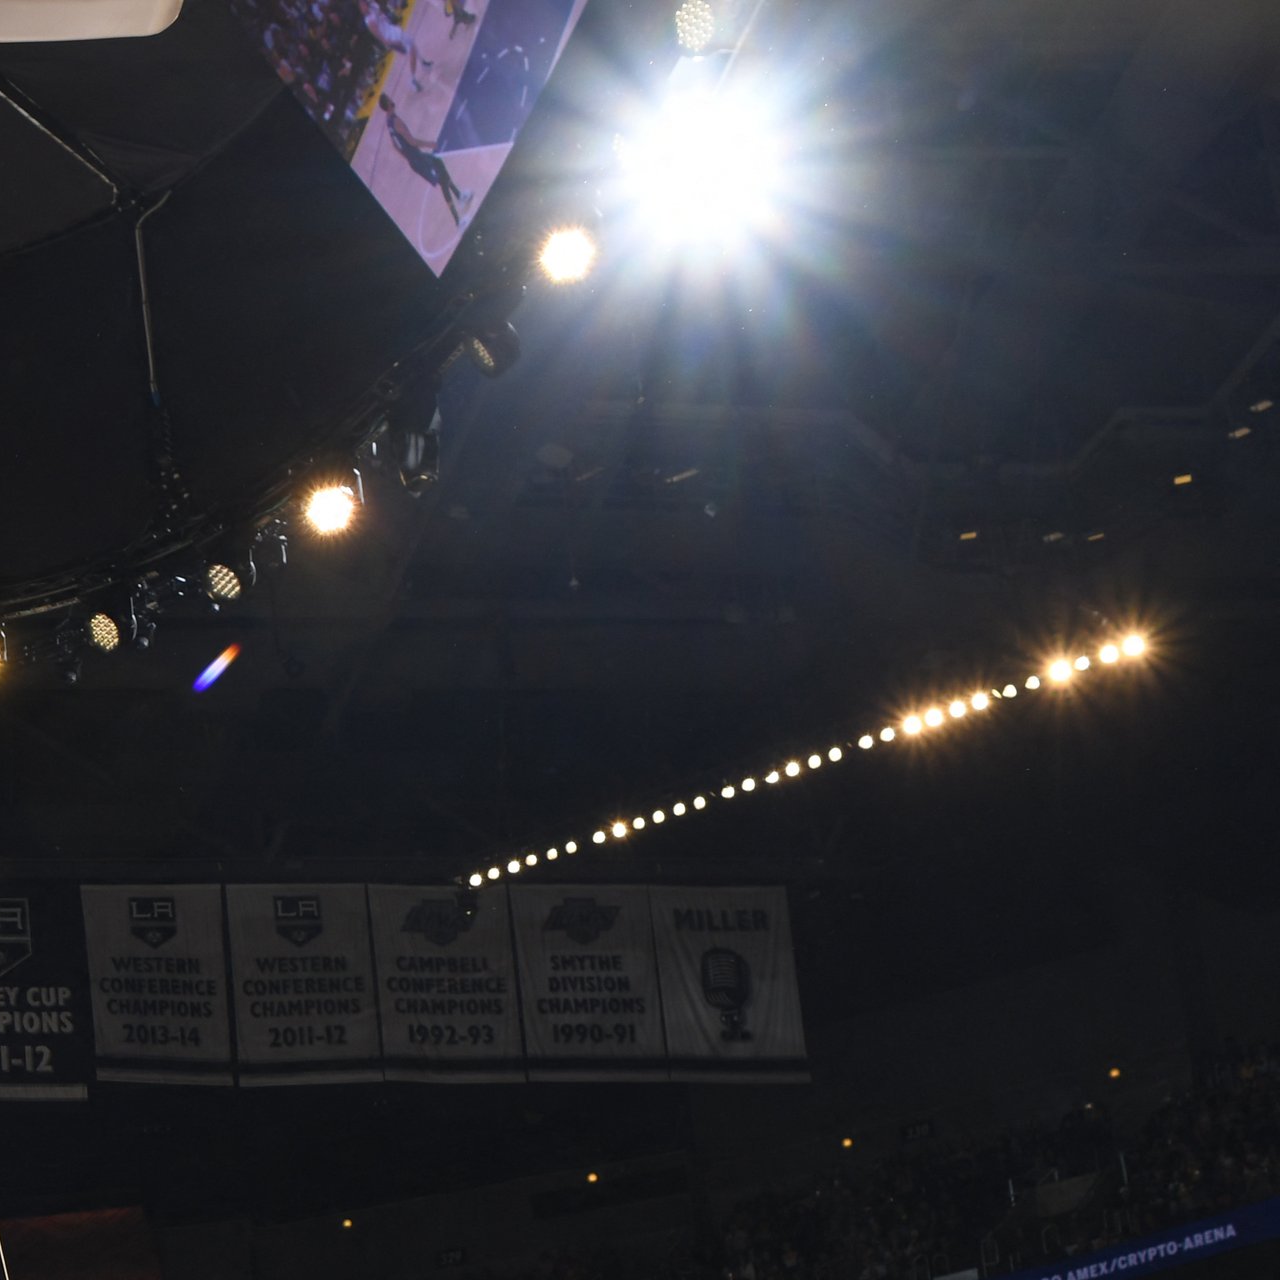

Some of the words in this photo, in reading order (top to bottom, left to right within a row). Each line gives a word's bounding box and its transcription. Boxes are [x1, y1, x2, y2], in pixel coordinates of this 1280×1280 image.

[130, 901, 174, 918] LA
[276, 900, 320, 917] LA
[673, 908, 770, 931] MILLER
[112, 957, 201, 975] WESTERN
[256, 956, 347, 973] WESTERN
[396, 956, 489, 973] CAMPBELL
[551, 954, 622, 971] SMYTHE
[99, 977, 217, 996] CONFERENCE
[243, 976, 365, 996] CONFERENCE
[386, 976, 507, 994] CONFERENCE
[548, 976, 630, 993] DIVISION
[27, 987, 71, 1006] CUP
[107, 999, 213, 1018] CHAMPIONS
[250, 999, 361, 1018] CHAMPIONS
[395, 999, 503, 1016] CHAMPIONS
[537, 998, 645, 1015] CHAMPIONS
[122, 1024, 201, 1047] 2013-14
[269, 1025, 347, 1047] 2011-12
[408, 1024, 495, 1045] 1992-93
[553, 1024, 636, 1045] 1990-91
